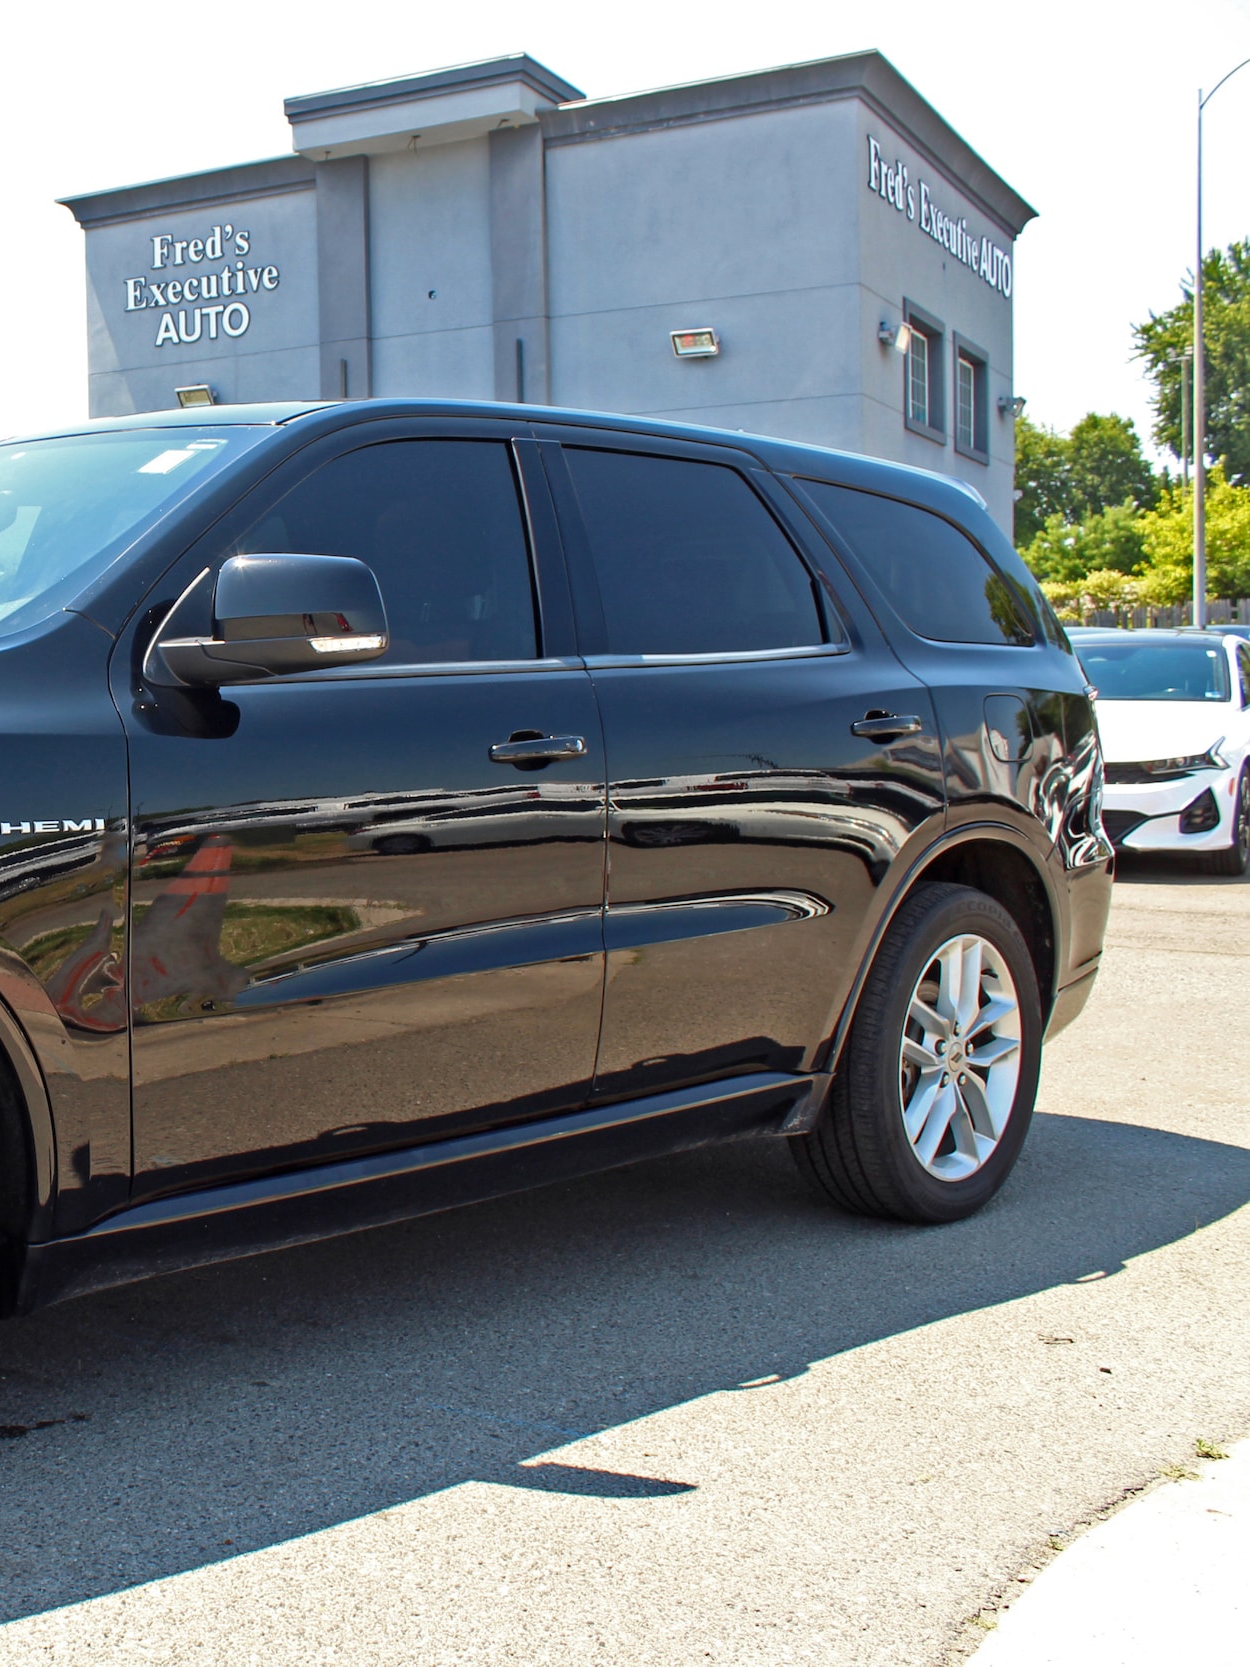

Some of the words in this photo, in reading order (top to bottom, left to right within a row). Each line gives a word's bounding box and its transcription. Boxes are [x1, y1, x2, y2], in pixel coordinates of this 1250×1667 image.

[867, 134, 915, 221] Fred's
[918, 179, 978, 272] Executive
[979, 236, 1012, 299] AUTO
[151, 224, 250, 270] Fred's
[124, 261, 280, 312] Executive
[154, 301, 250, 347] AUTO
[0, 818, 105, 835] HEMI
